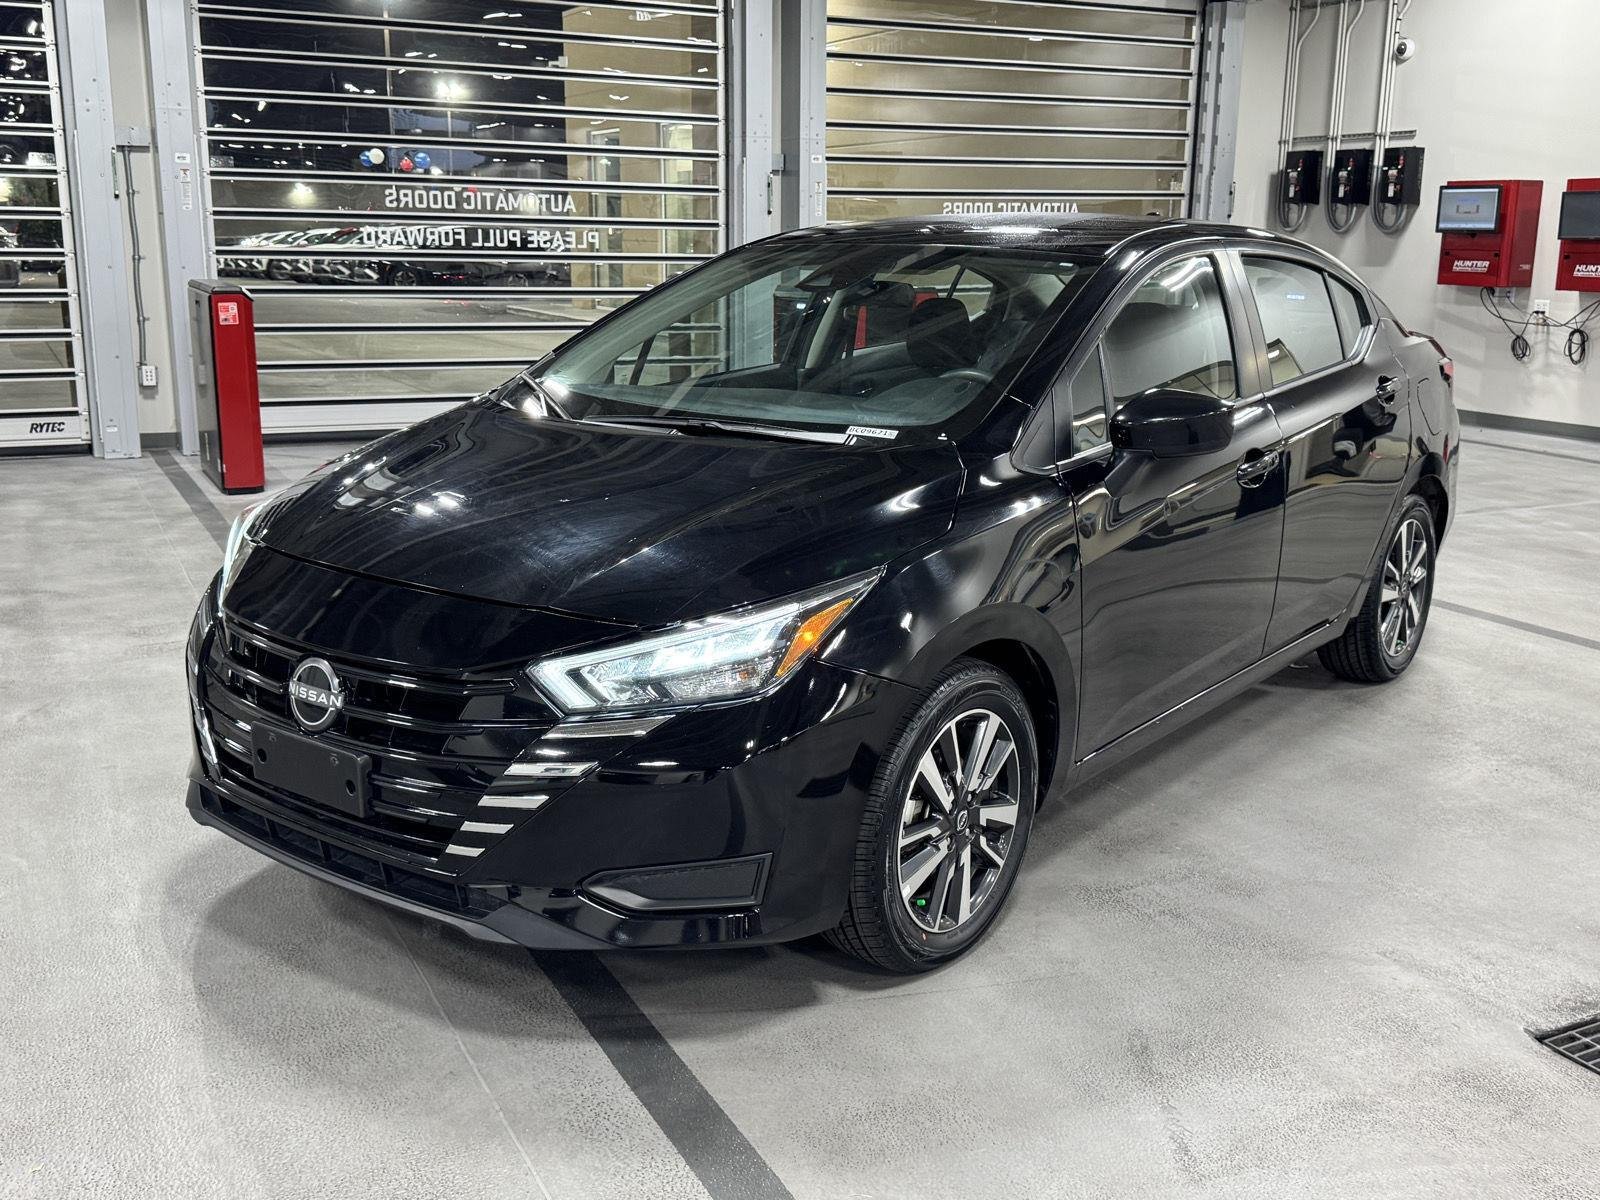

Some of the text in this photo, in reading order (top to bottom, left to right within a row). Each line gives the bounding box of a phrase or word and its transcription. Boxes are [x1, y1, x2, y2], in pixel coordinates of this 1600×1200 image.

[1454, 260, 1490, 268] HUNTER
[29, 421, 66, 433] RYTEC
[289, 681, 342, 707] NISSAN
